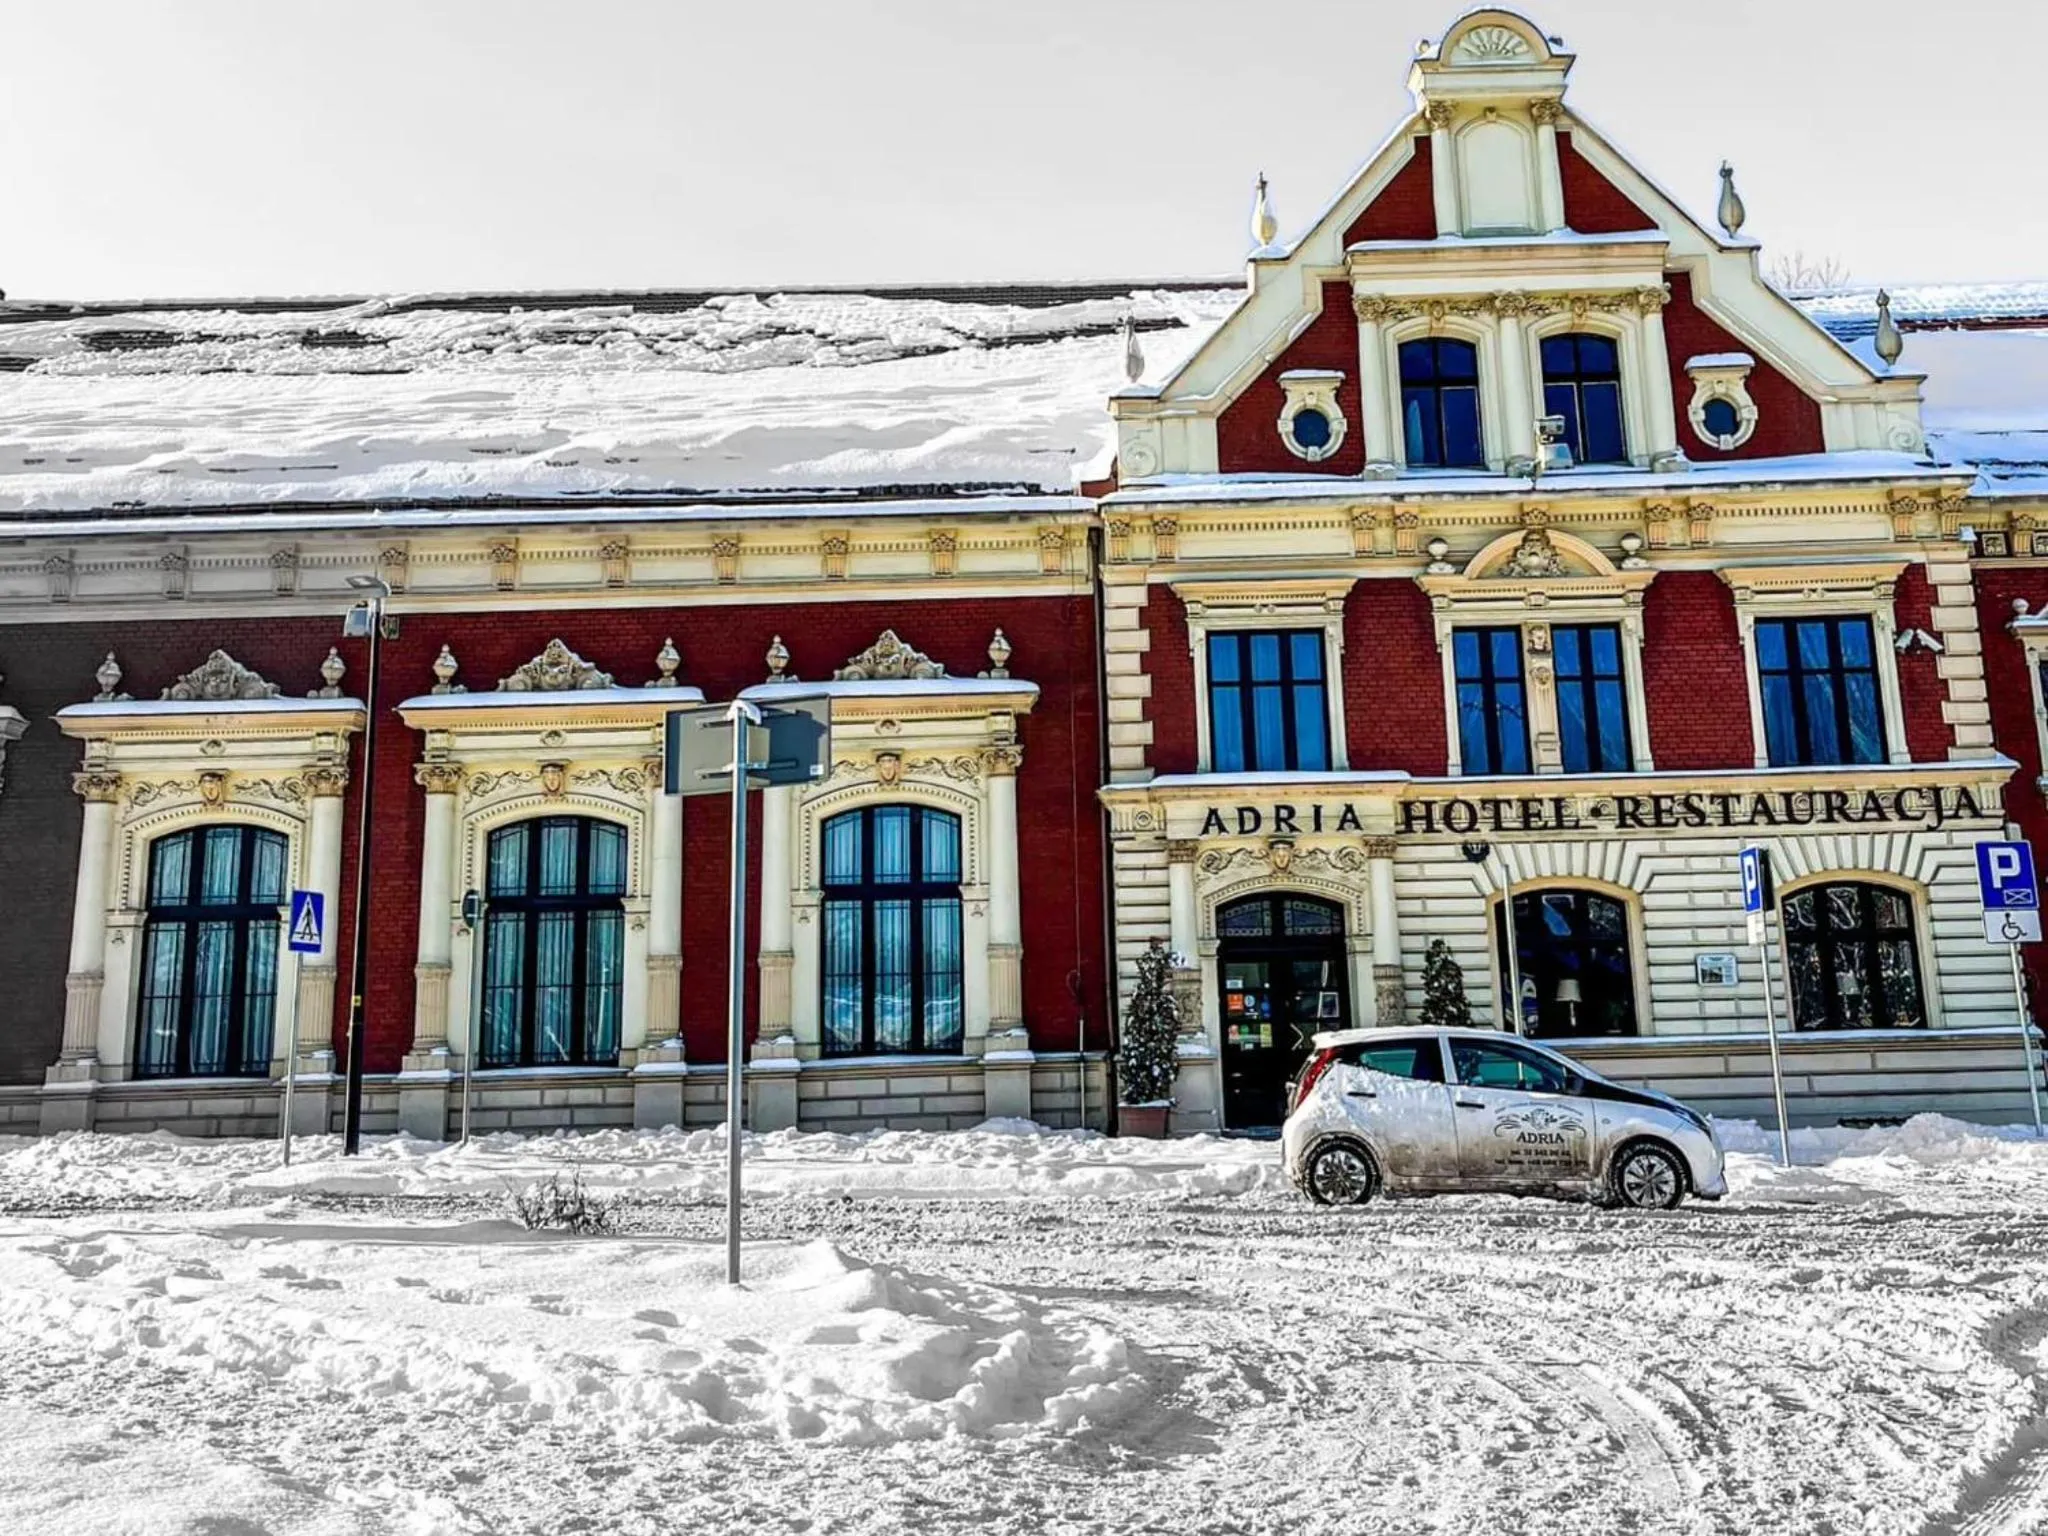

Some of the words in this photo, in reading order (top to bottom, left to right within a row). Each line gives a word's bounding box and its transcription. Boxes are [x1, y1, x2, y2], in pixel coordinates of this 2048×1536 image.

[1199, 803, 1364, 836] ADRIA
[1394, 797, 1597, 834] HOTEL
[1612, 786, 1983, 831] RESTAURACJA
[1742, 854, 1758, 905] P
[1987, 847, 2021, 889] P
[1516, 1131, 1565, 1144] ADRIA
